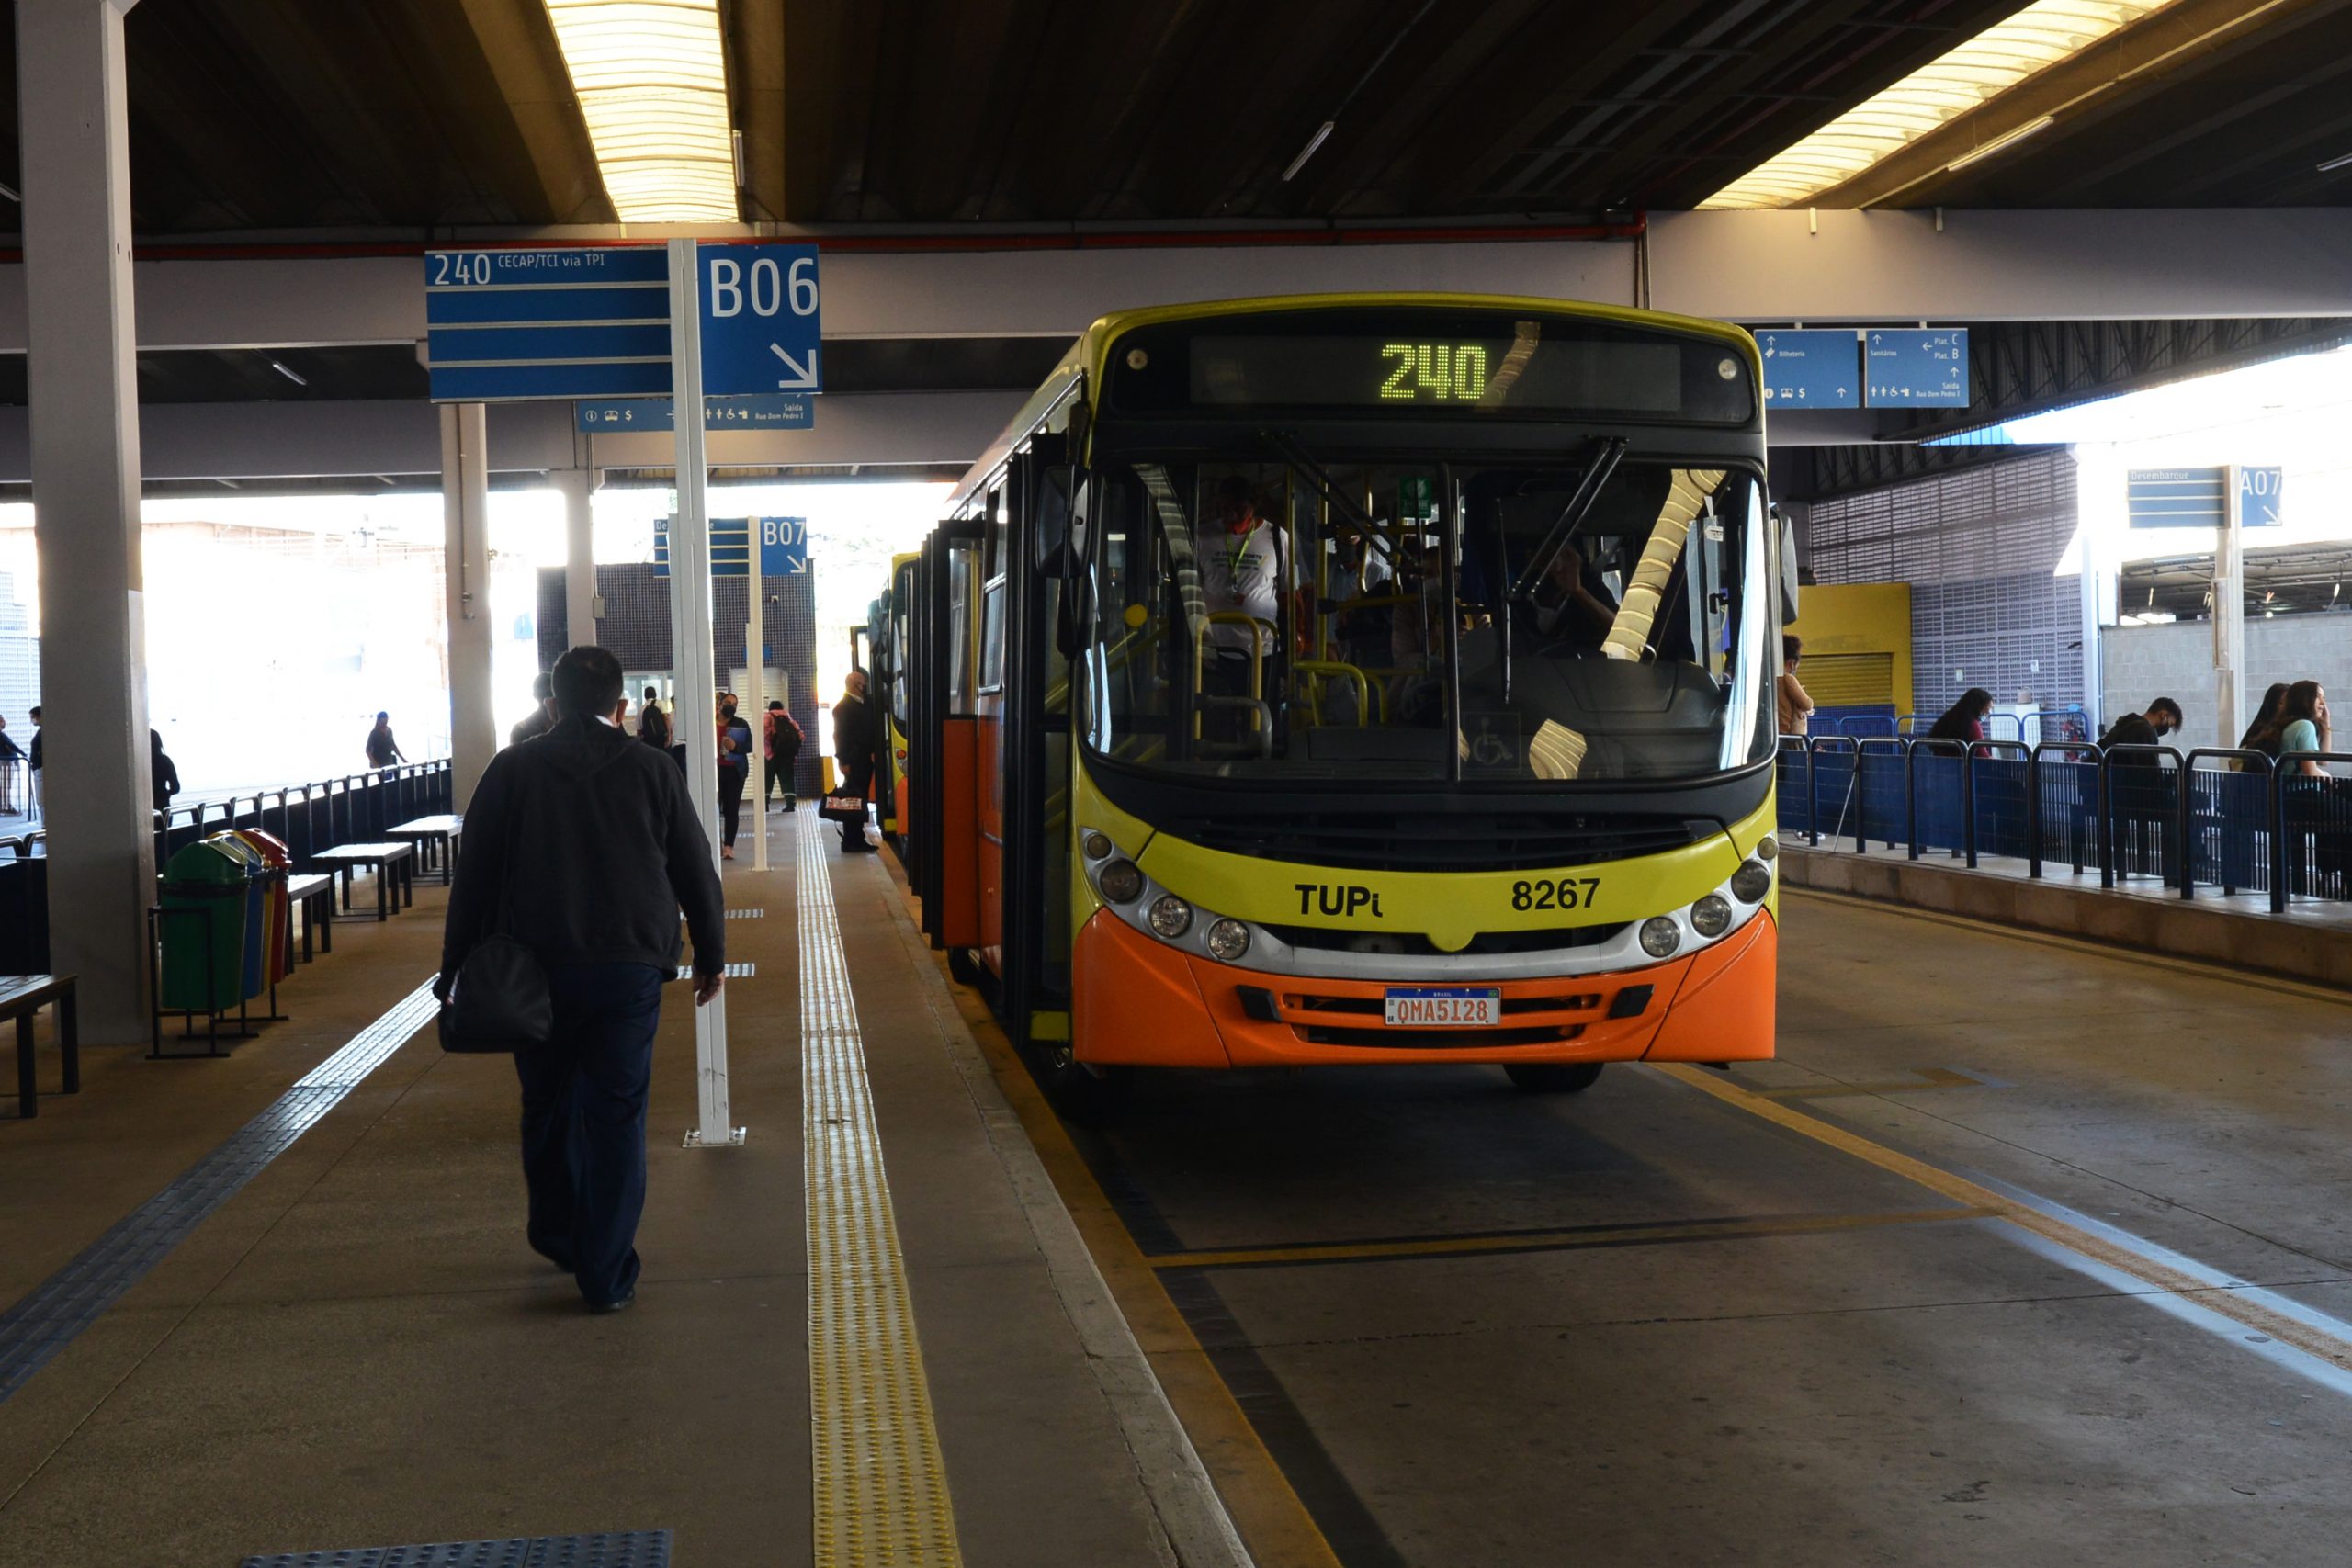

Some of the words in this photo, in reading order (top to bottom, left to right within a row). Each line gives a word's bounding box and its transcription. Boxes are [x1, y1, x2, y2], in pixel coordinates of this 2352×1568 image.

[434, 254, 492, 286] 240
[498, 254, 559, 269] CECAP/TCI
[562, 255, 582, 267] via
[585, 254, 605, 267] TPI
[710, 257, 819, 318] B06
[1951, 333, 1958, 345] C
[1951, 348, 1959, 359] B
[1381, 344, 1486, 399] 240
[2131, 469, 2189, 482] Desembarque
[2241, 471, 2280, 495] A07
[763, 521, 806, 546] B07
[1295, 883, 1383, 918] TUPi
[1511, 877, 1600, 912] 8267
